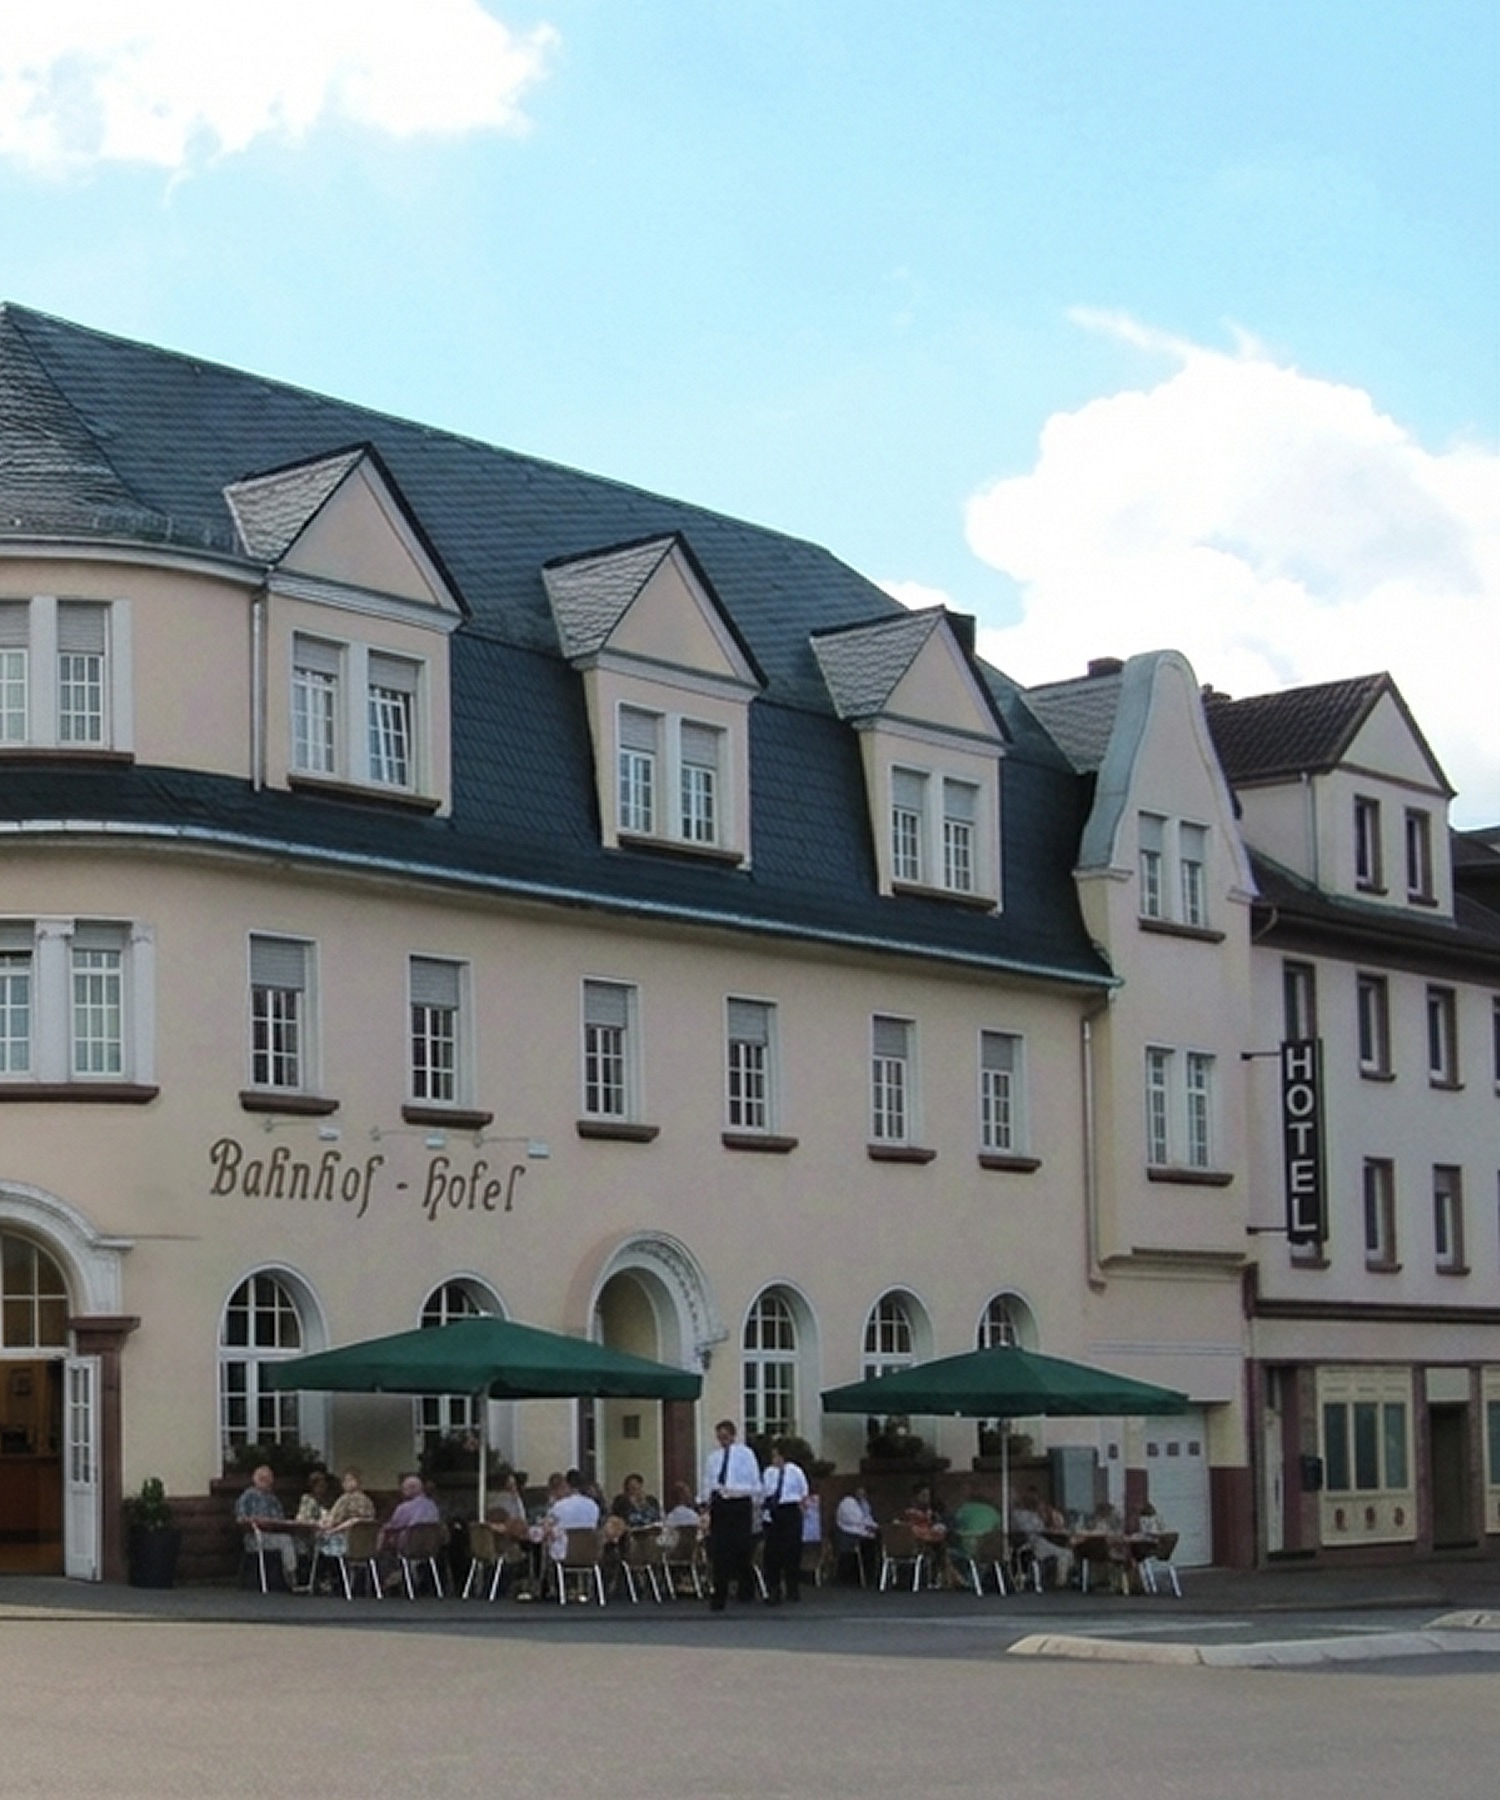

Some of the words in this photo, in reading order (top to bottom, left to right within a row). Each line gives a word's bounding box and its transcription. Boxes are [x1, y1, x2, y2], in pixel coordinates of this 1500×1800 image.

[209, 1138, 385, 1220] Bahnhof
[422, 1156, 527, 1222] Hotel
[1286, 1046, 1318, 1232] HOTEL
